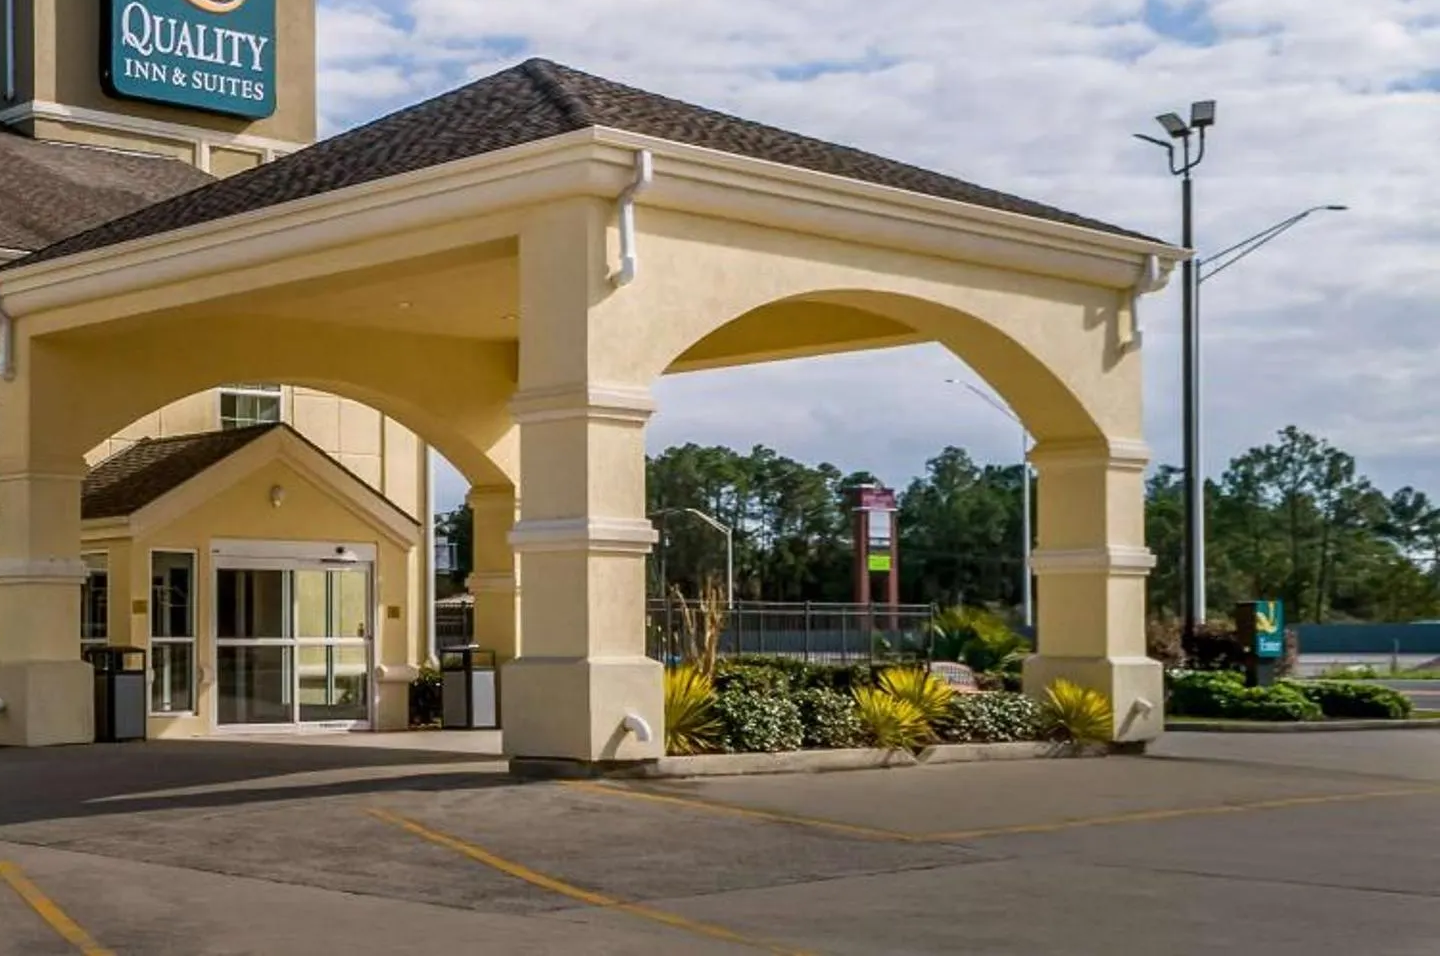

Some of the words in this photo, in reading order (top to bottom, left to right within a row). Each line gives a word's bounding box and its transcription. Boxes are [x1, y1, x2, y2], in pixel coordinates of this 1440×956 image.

[122, 1, 268, 71] QUALITY
[124, 58, 167, 83] INN
[171, 67, 187, 87] &
[191, 72, 265, 101] SUITES
